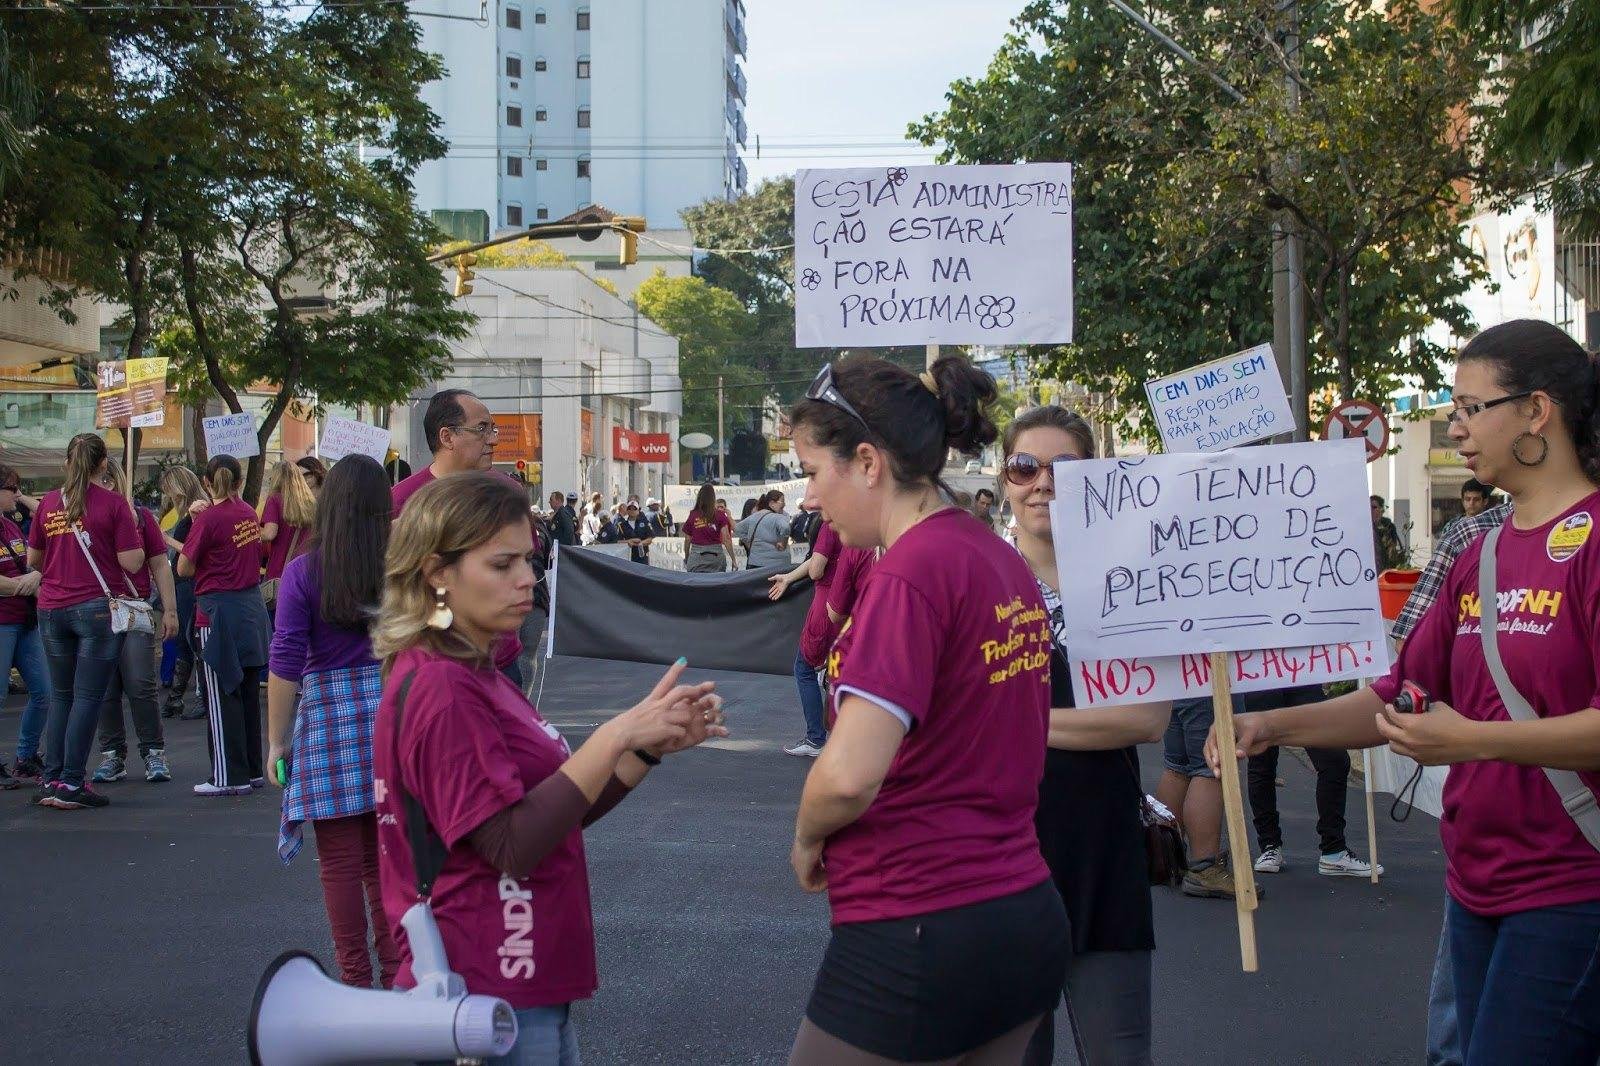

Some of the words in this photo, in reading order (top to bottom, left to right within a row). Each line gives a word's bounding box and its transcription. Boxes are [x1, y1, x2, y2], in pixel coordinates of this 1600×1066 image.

[813, 209, 867, 258] ÇÃO
[889, 212, 1014, 246] ESTARÁ
[834, 257, 909, 290] FORA
[932, 256, 972, 283] NA
[840, 289, 972, 328] PRÓXIMA
[1155, 381, 1190, 403] CEM
[1195, 367, 1229, 391] DIAS
[1232, 355, 1266, 379] SEM
[1164, 384, 1260, 425] RESPOSTAS
[1167, 422, 1202, 440] PARA
[1208, 414, 1218, 427] A
[642, 442, 668, 454] vivo
[1196, 405, 1276, 450] EDUCAÇÃO
[1084, 458, 1160, 528] NÃO
[1178, 463, 1317, 501] TENHO
[1150, 514, 1258, 557] MEDO
[1284, 505, 1338, 539] DE
[1101, 530, 1376, 618] PERSEGUIÇÃO.
[1509, 617, 1554, 635] fortes!
[1081, 656, 1157, 705] NOS
